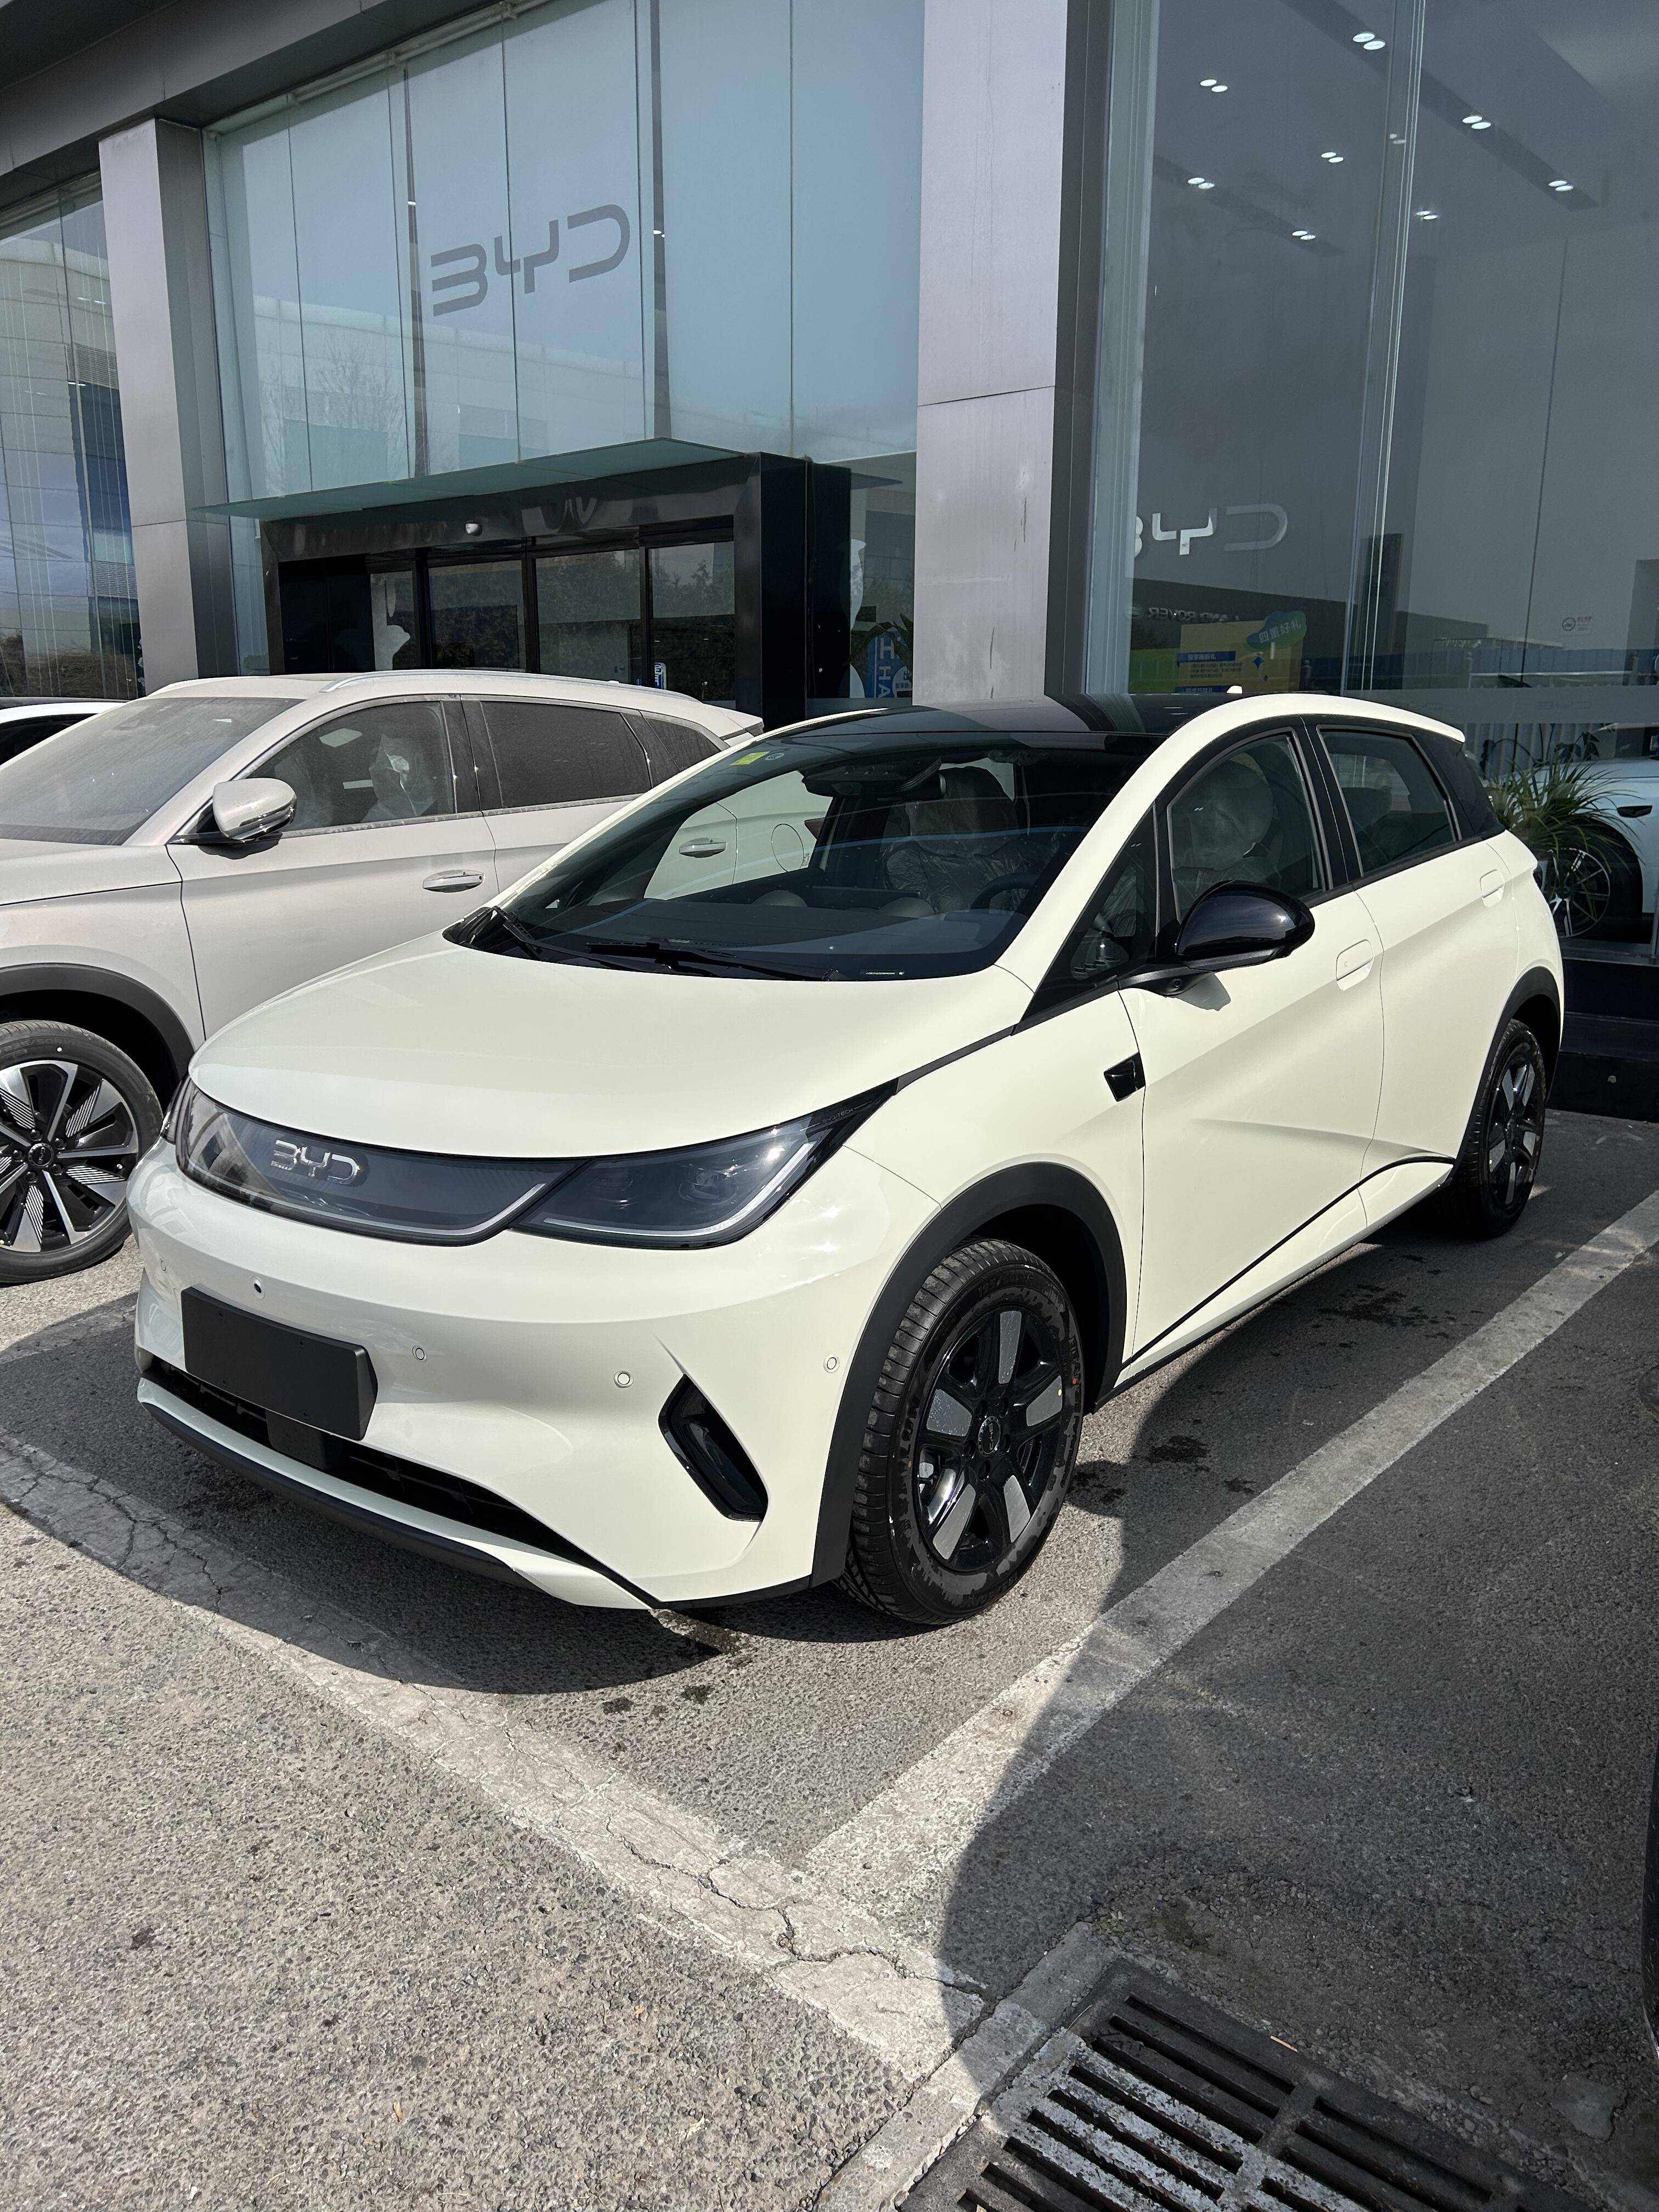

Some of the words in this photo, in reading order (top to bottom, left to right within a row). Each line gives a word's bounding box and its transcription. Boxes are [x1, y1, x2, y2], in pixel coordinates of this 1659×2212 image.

[431, 204, 630, 317] BYD
[1134, 503, 1288, 557] YD
[270, 1139, 360, 1184] BYD
